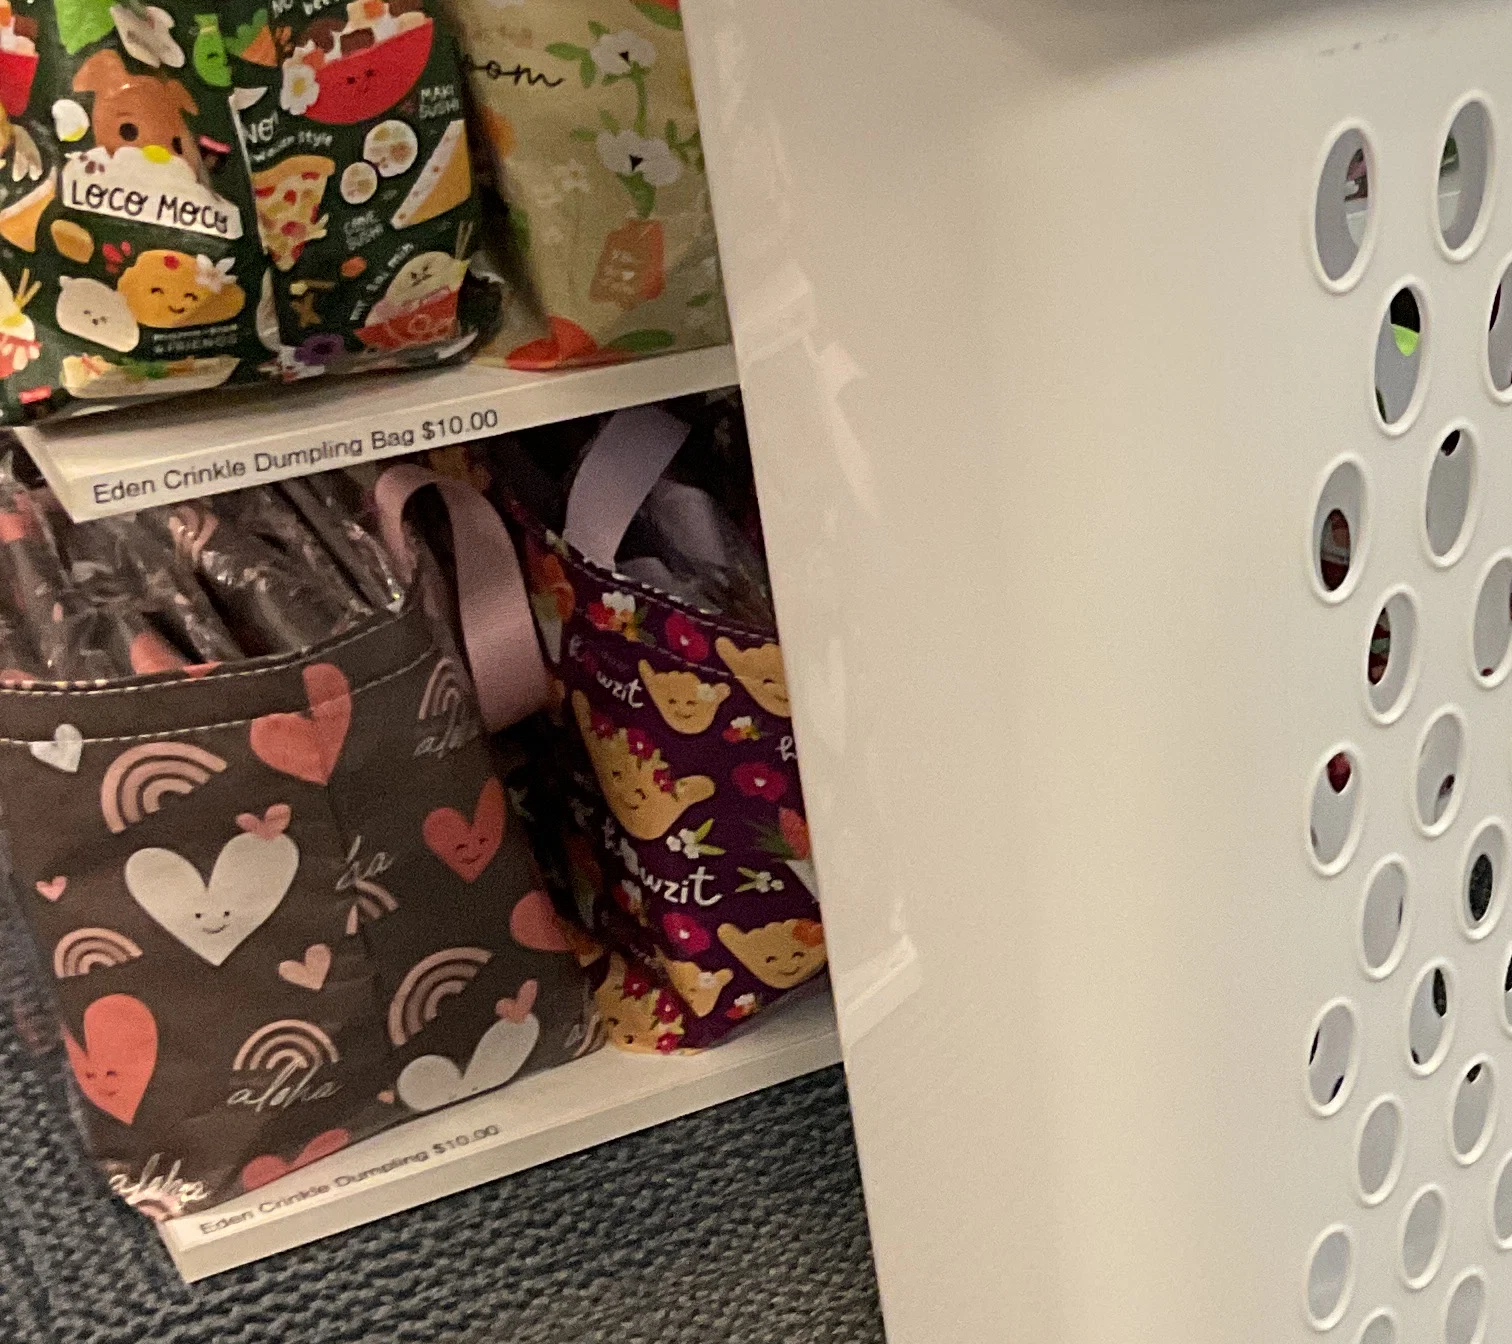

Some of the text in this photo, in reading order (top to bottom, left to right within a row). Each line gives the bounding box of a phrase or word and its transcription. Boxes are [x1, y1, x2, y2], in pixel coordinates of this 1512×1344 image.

[71, 179, 229, 235] LOCO MOCO
[92, 408, 499, 505] Eden Crinkle Dumpling Bag $10.00
[226, 1053, 344, 1113] aloha
[198, 1123, 501, 1236] Eden Crinkle Dumpling $10.00
